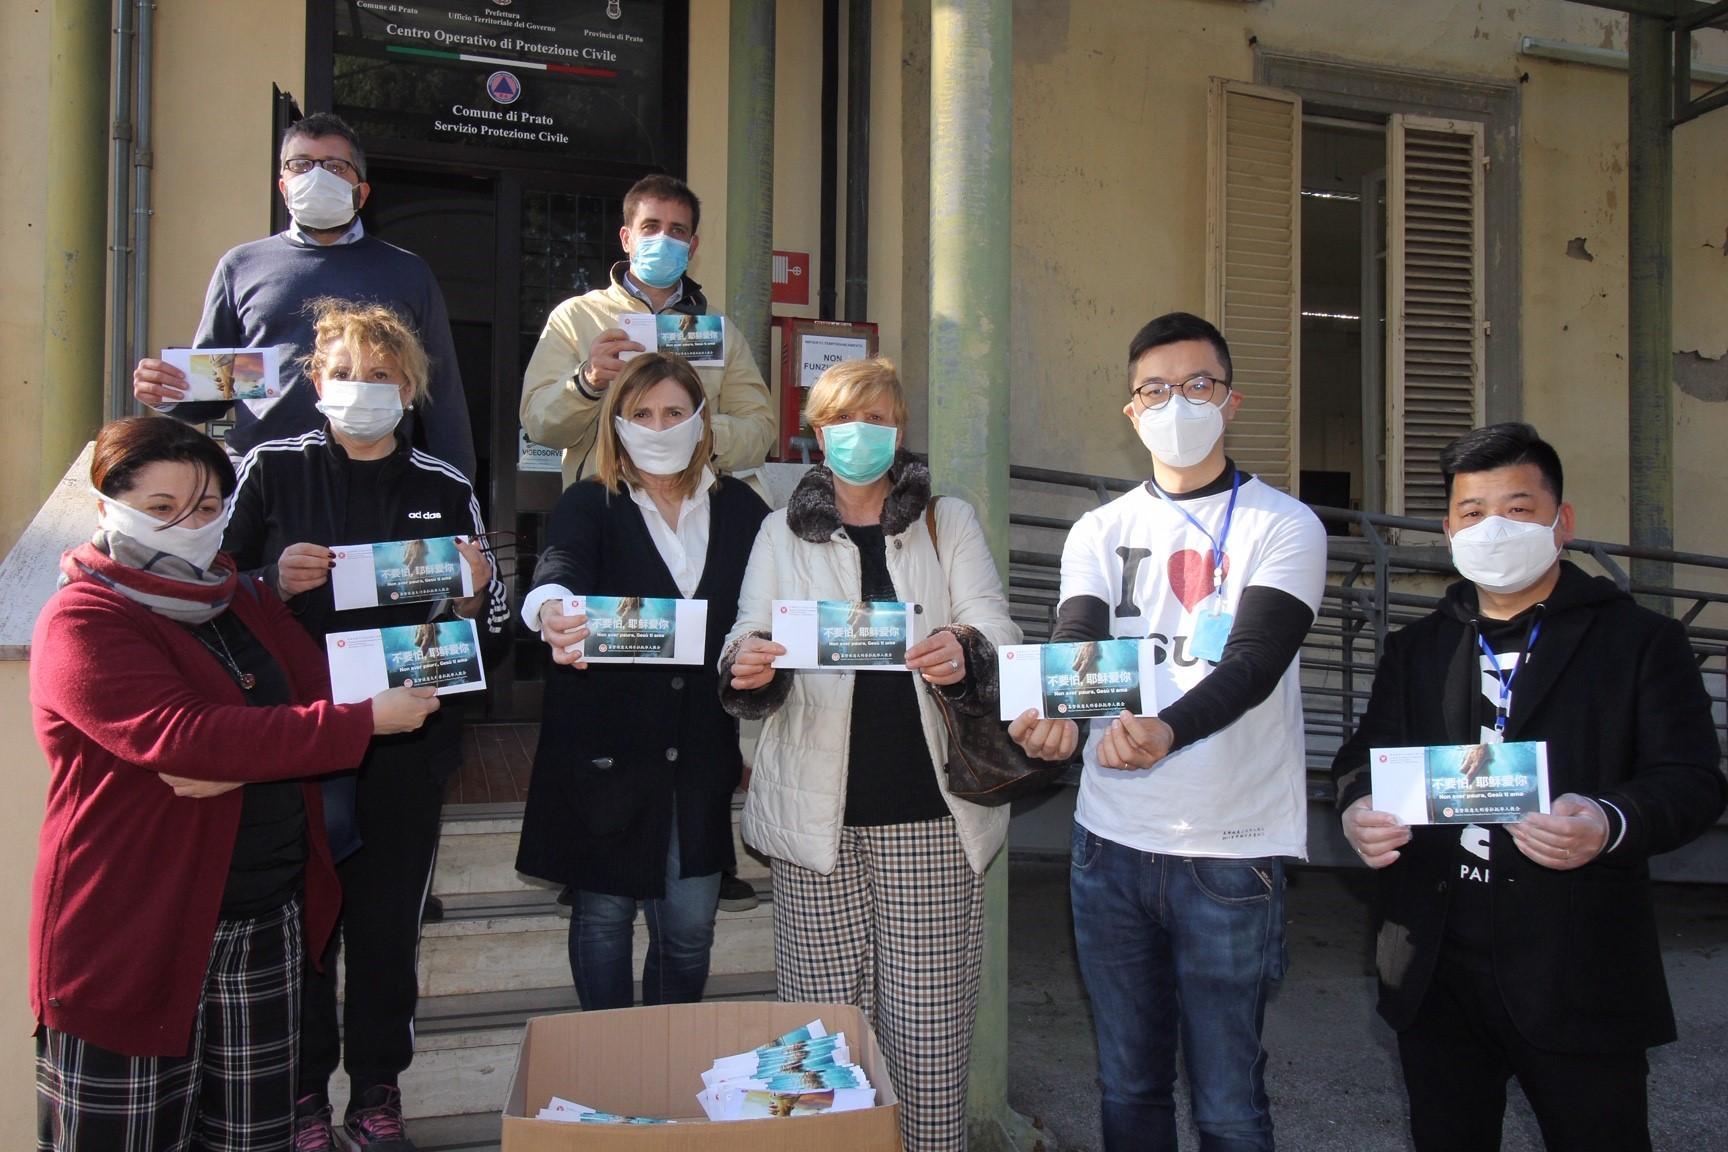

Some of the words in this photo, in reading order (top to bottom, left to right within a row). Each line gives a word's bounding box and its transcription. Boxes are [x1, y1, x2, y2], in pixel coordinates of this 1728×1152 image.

[356, 0, 388, 10] Comune
[388, 4, 397, 12] di
[398, 6, 418, 14] Prato
[485, 9, 520, 19] Prefettura
[448, 12, 472, 21] Ufficio
[474, 15, 513, 27] Territoriale
[514, 20, 525, 28] del
[526, 22, 556, 32] Governo
[386, 23, 431, 40] Centro
[434, 29, 497, 48] Operativo
[500, 38, 512, 50] di
[516, 39, 579, 57] Protezione
[582, 48, 617, 62] Civile
[584, 29, 615, 39] Provincia
[625, 34, 644, 42] Prato
[452, 105, 503, 120] Comune
[506, 111, 518, 121] di
[521, 112, 554, 125] Prato
[434, 120, 478, 135] Servizio
[481, 125, 536, 140] Protezione
[538, 131, 569, 143] Civile
[824, 354, 842, 362] NON
[522, 448, 564, 457] VIDEOSORVE
[408, 510, 442, 520] addas
[1115, 546, 1152, 618] I
